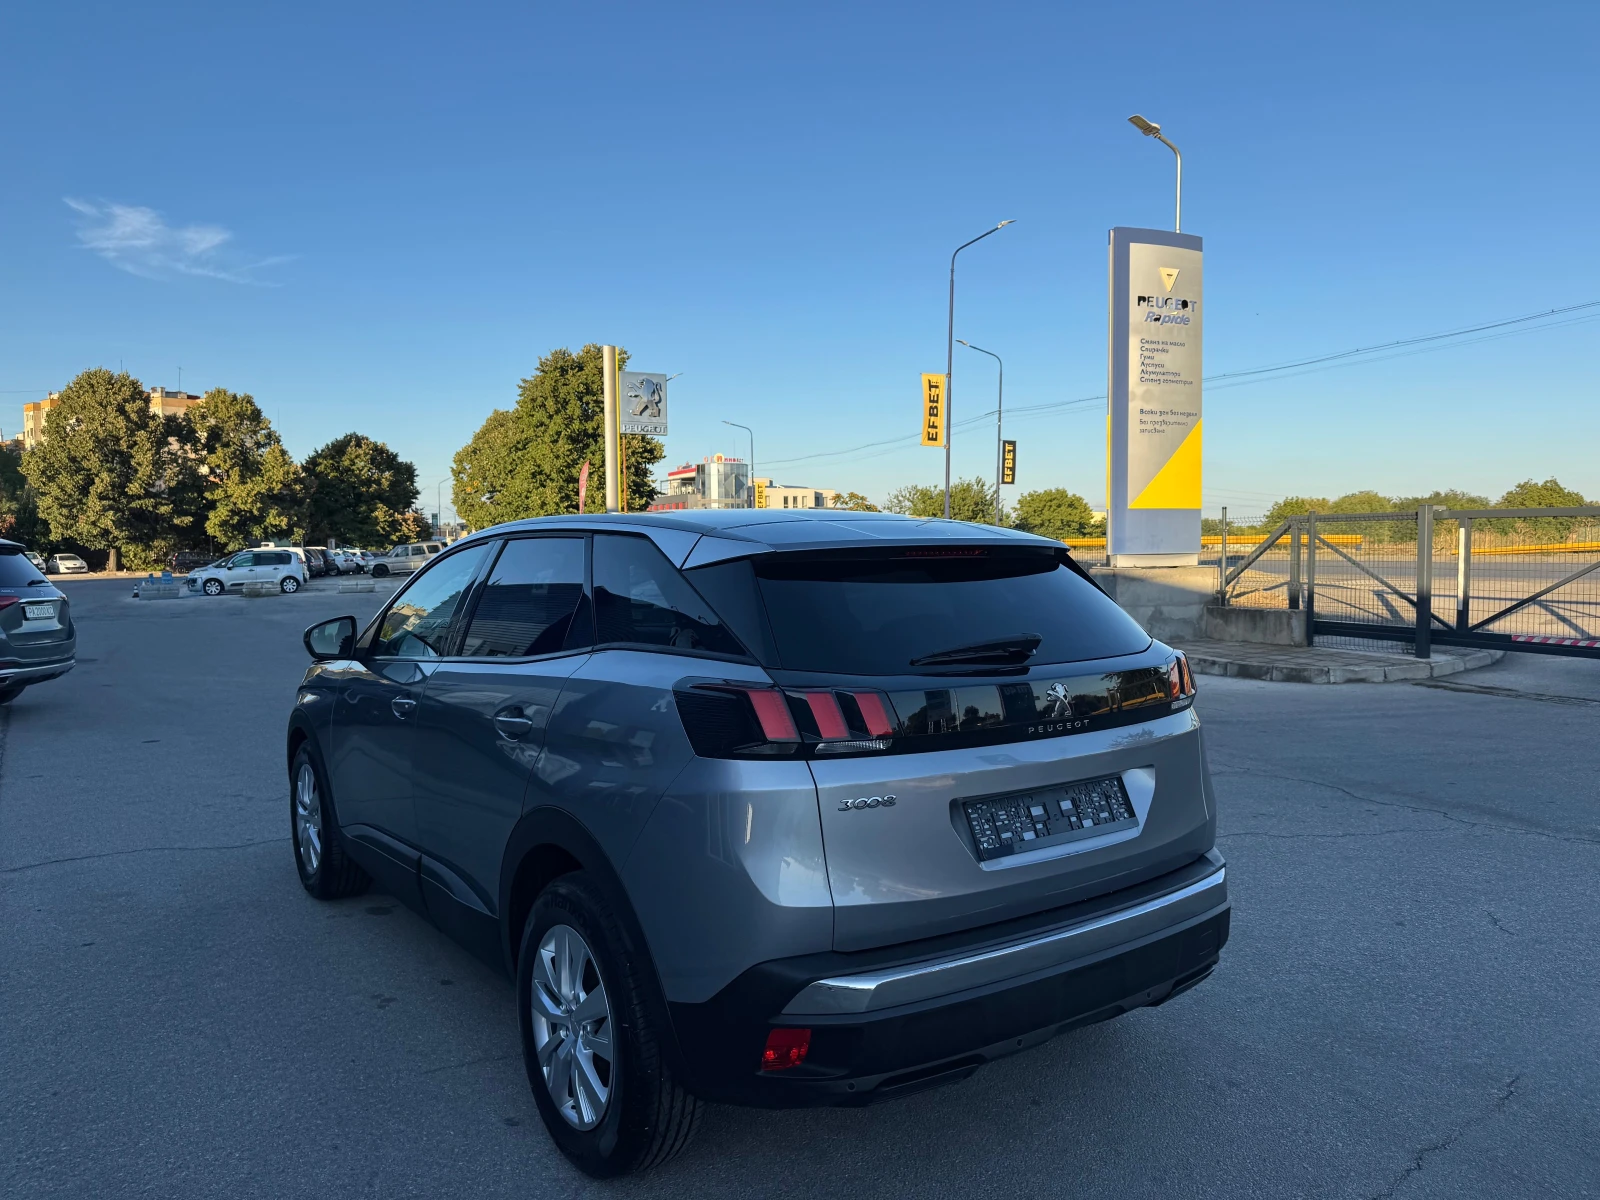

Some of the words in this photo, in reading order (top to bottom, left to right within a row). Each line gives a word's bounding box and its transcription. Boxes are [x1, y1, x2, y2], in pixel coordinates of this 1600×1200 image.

[1137, 295, 1197, 312] PEUGEOT
[1144, 311, 1190, 325] Rapide
[1140, 353, 1155, 361] Гуми
[927, 378, 940, 442] EFBET
[622, 424, 667, 433] PEUGEOT
[1003, 442, 1014, 483] EFBET
[1028, 719, 1090, 734] PEUGEOT
[838, 794, 897, 811] 3008
